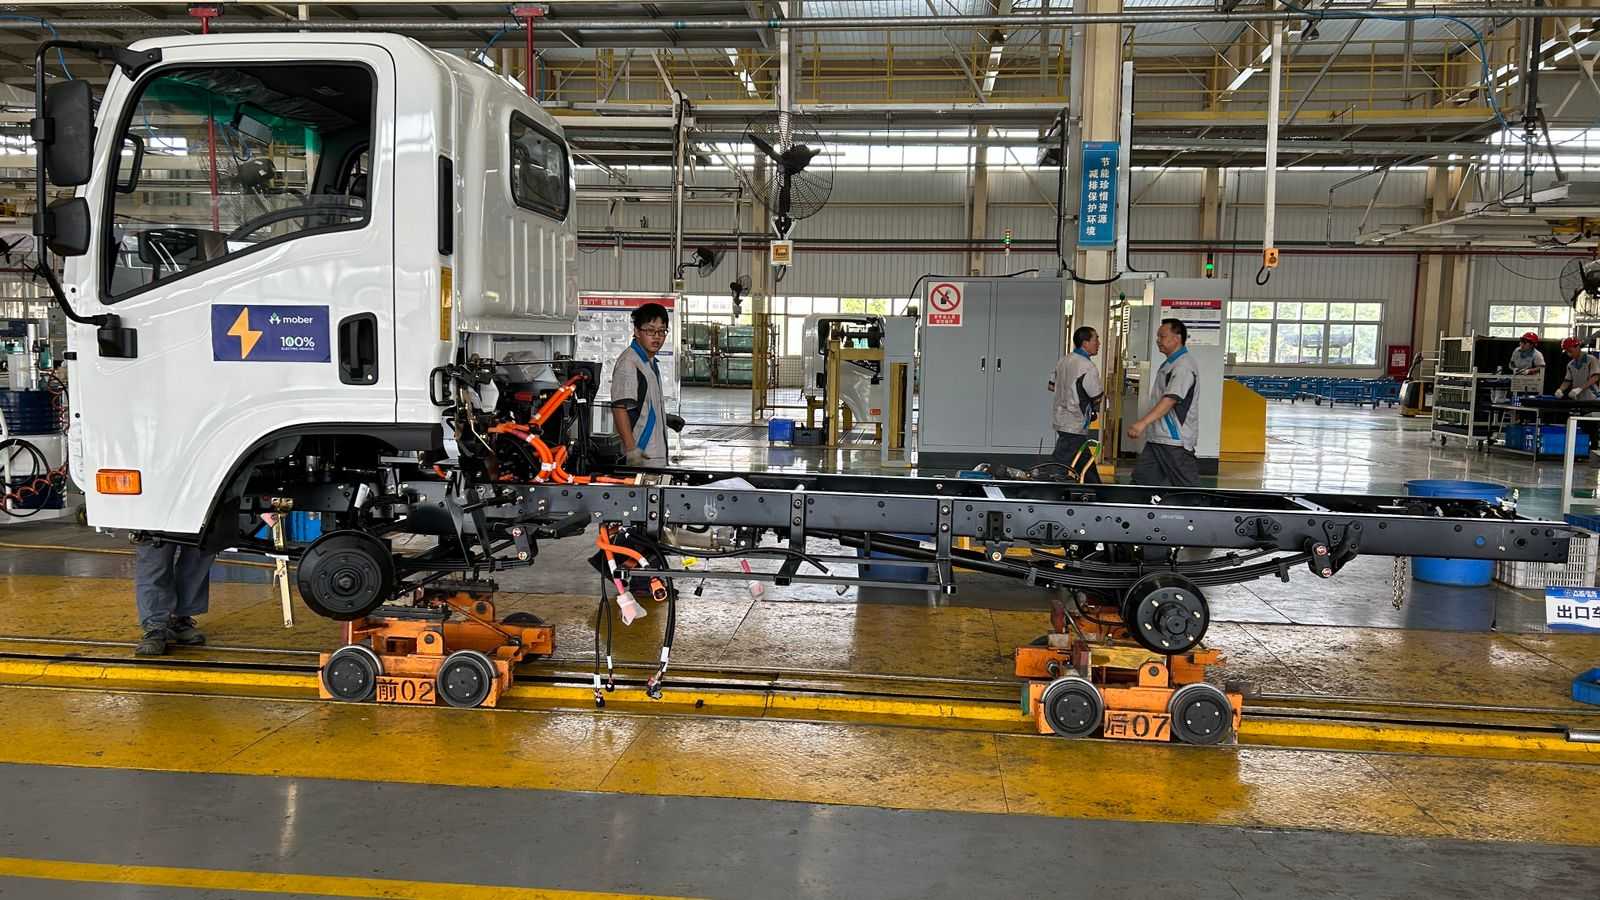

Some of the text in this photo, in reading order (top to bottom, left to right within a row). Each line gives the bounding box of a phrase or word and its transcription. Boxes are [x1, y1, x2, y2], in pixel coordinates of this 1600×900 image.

[283, 316, 313, 324] mober
[280, 336, 315, 347] 100%
[377, 678, 433, 702] 前02
[1104, 713, 1170, 738] 后07
